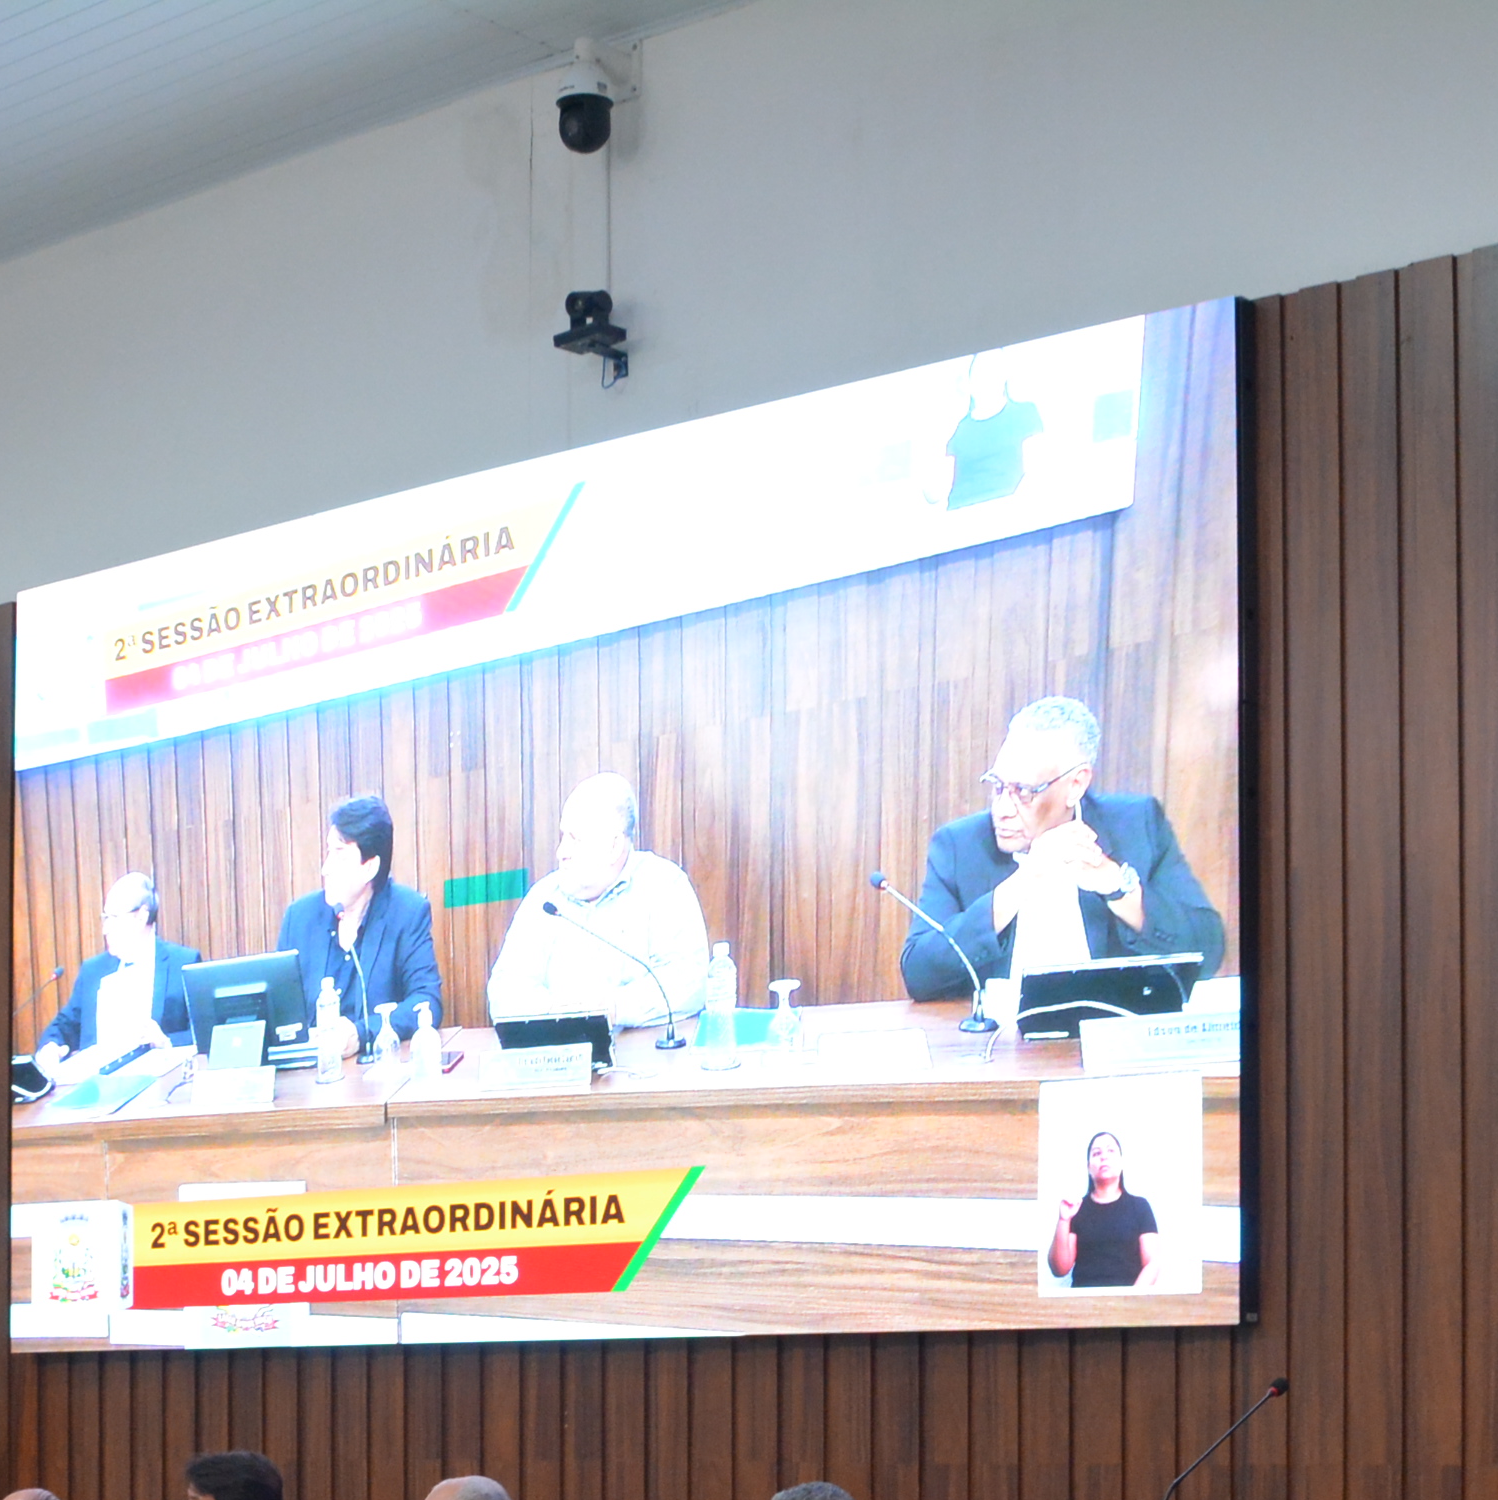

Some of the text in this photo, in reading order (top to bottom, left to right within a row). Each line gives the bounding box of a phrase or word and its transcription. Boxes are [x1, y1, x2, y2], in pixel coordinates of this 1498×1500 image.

[141, 606, 241, 654] SESSÃO
[248, 526, 515, 625] EXTRAORDINÁRIA
[151, 1189, 626, 1249] 2ª SESSÃO EXTRAORDINÁRIA
[220, 1255, 520, 1297] 04 DE JULHO DE 2025
